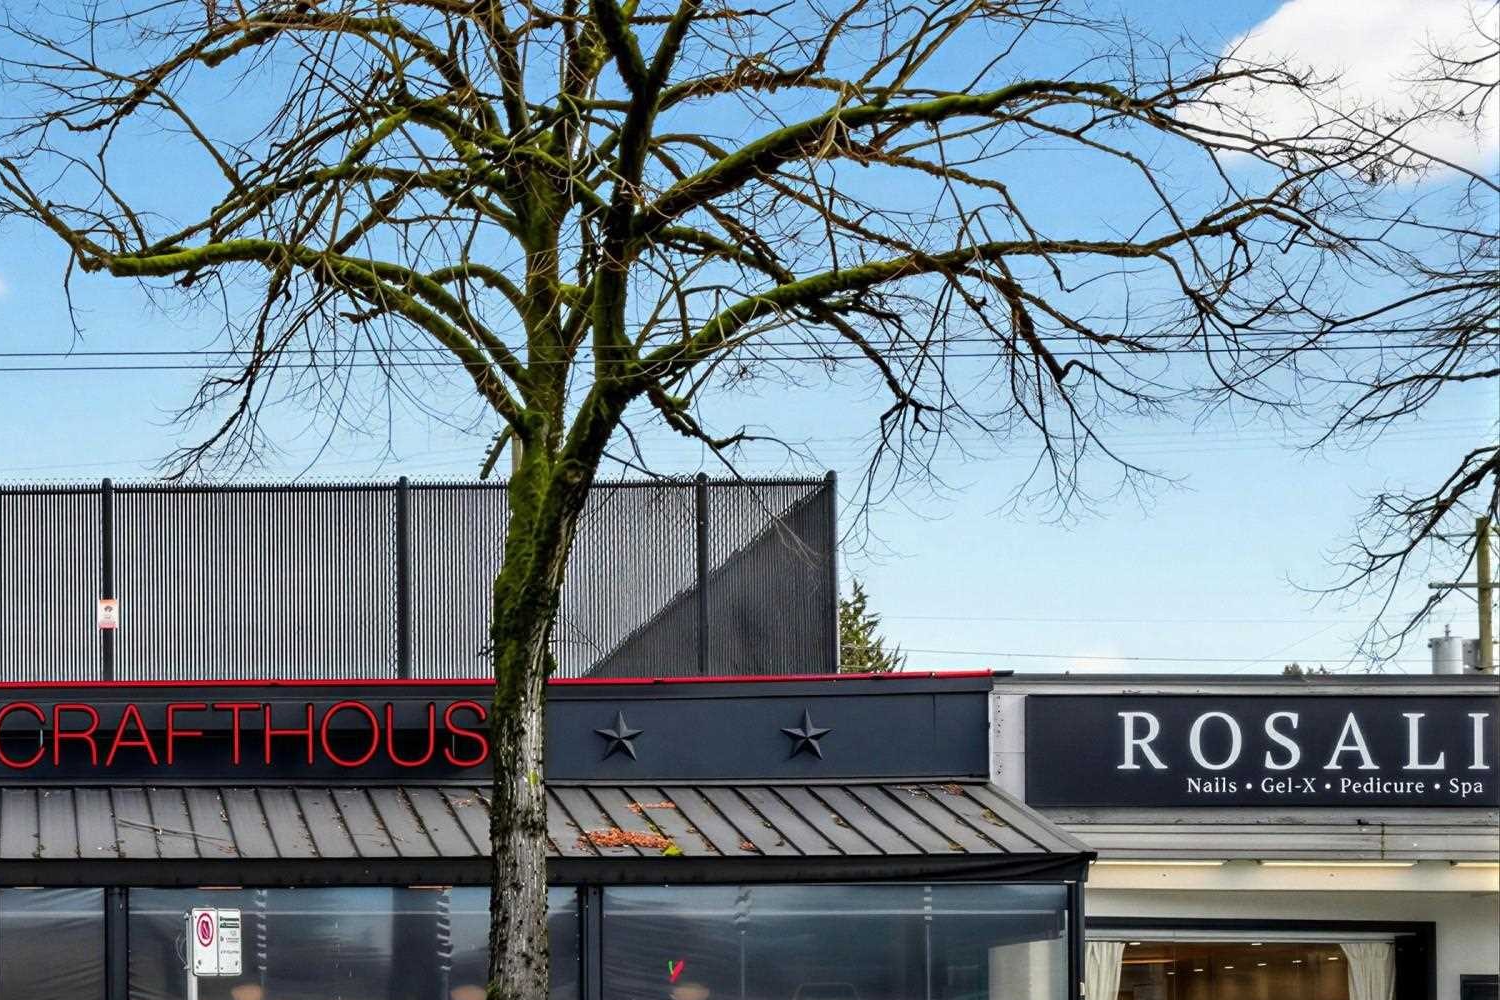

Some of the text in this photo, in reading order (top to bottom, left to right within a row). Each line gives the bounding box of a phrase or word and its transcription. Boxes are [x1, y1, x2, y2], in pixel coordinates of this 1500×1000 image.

[1116, 711, 1491, 771] ROSALI
[1186, 777, 1485, 799] Nails Gel-X Pedicure Spa
